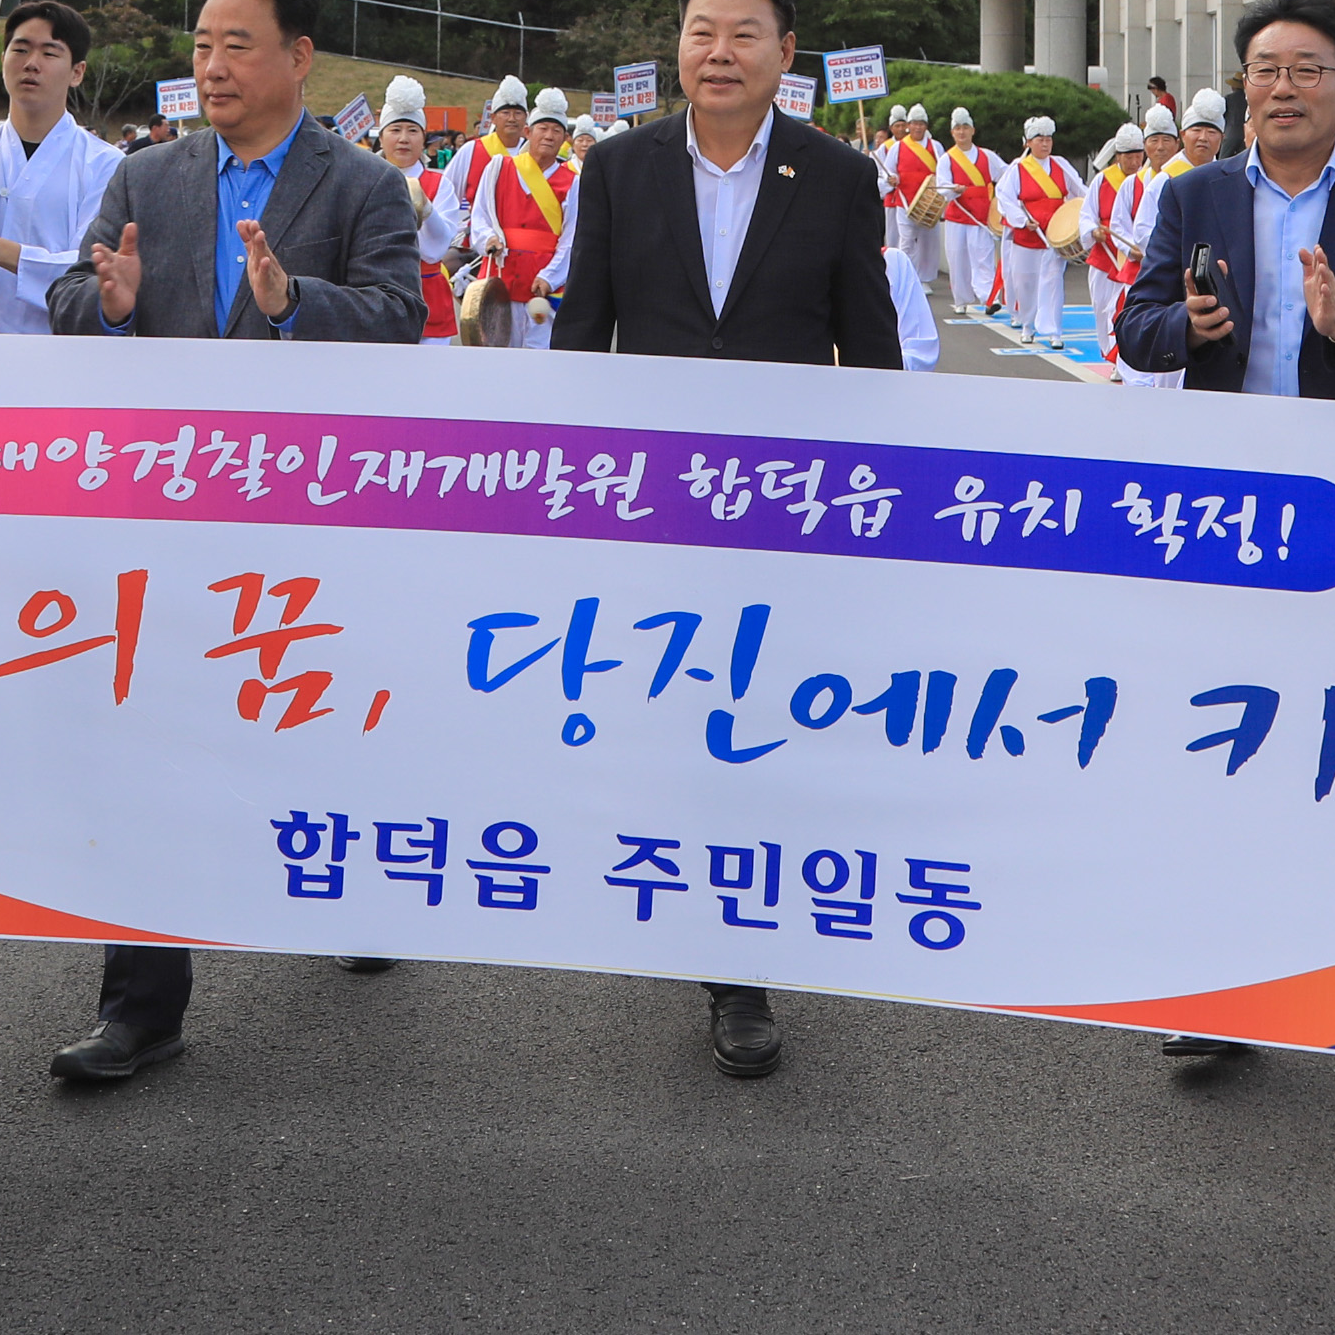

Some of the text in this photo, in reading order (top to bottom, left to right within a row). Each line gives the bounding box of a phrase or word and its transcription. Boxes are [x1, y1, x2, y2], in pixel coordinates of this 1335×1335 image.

[620, 95, 634, 108] 유치
[832, 65, 873, 79] 당진 합덕
[832, 76, 883, 94] 유치 확정!
[678, 453, 903, 539] 합덕읍
[933, 475, 1082, 546] 유치
[1112, 482, 1296, 565] 확정!
[203, 572, 391, 737] 꿈,
[465, 596, 1118, 770] 당진에서
[269, 809, 982, 951] 합덕읍 주민일동
